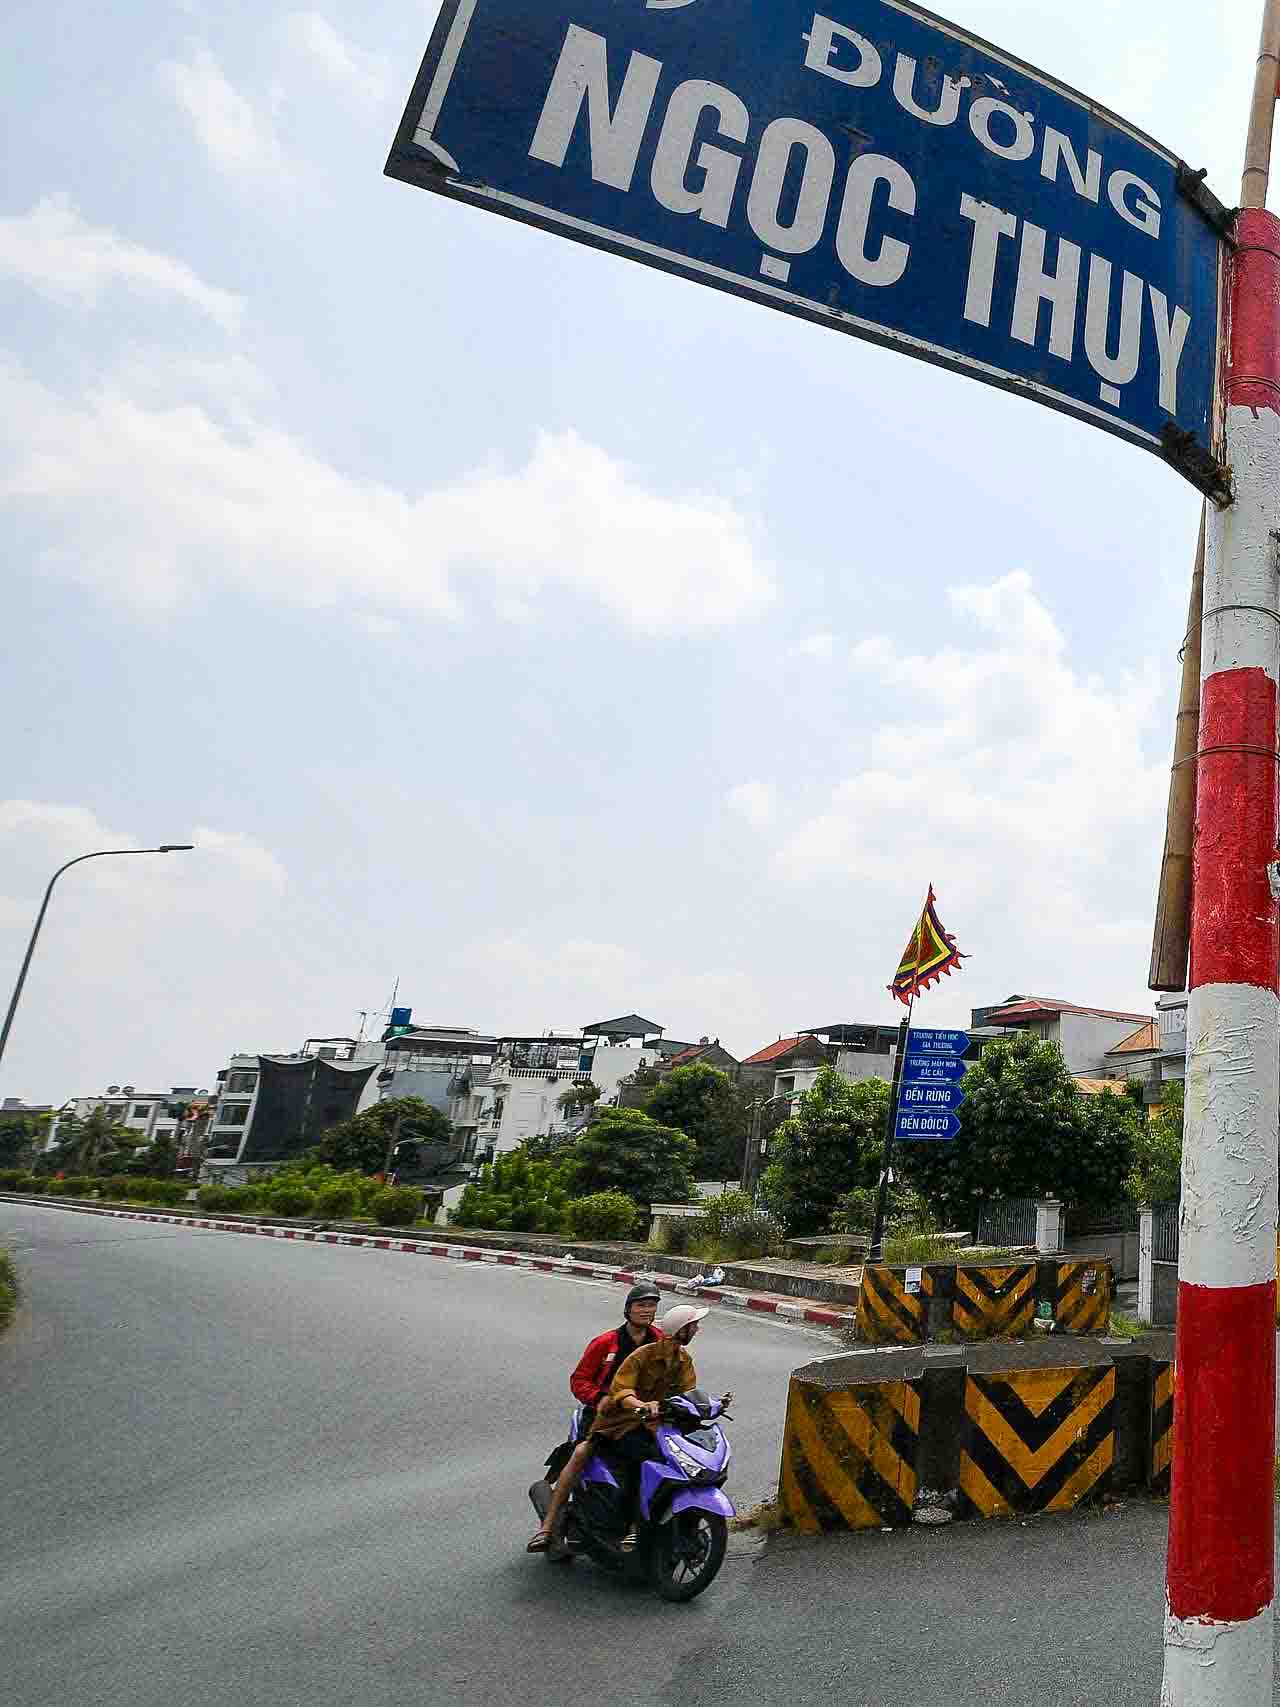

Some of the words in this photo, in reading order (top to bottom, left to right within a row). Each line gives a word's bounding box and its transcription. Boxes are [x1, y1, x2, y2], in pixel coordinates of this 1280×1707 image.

[801, 12, 1162, 239] ĐƯỜNG
[528, 22, 917, 286] NGỌC
[959, 192, 1192, 417] THỤY
[900, 1115, 919, 1129] ĐỀN
[905, 1086, 924, 1101] ĐỀN
[926, 1087, 951, 1102] RỪNG
